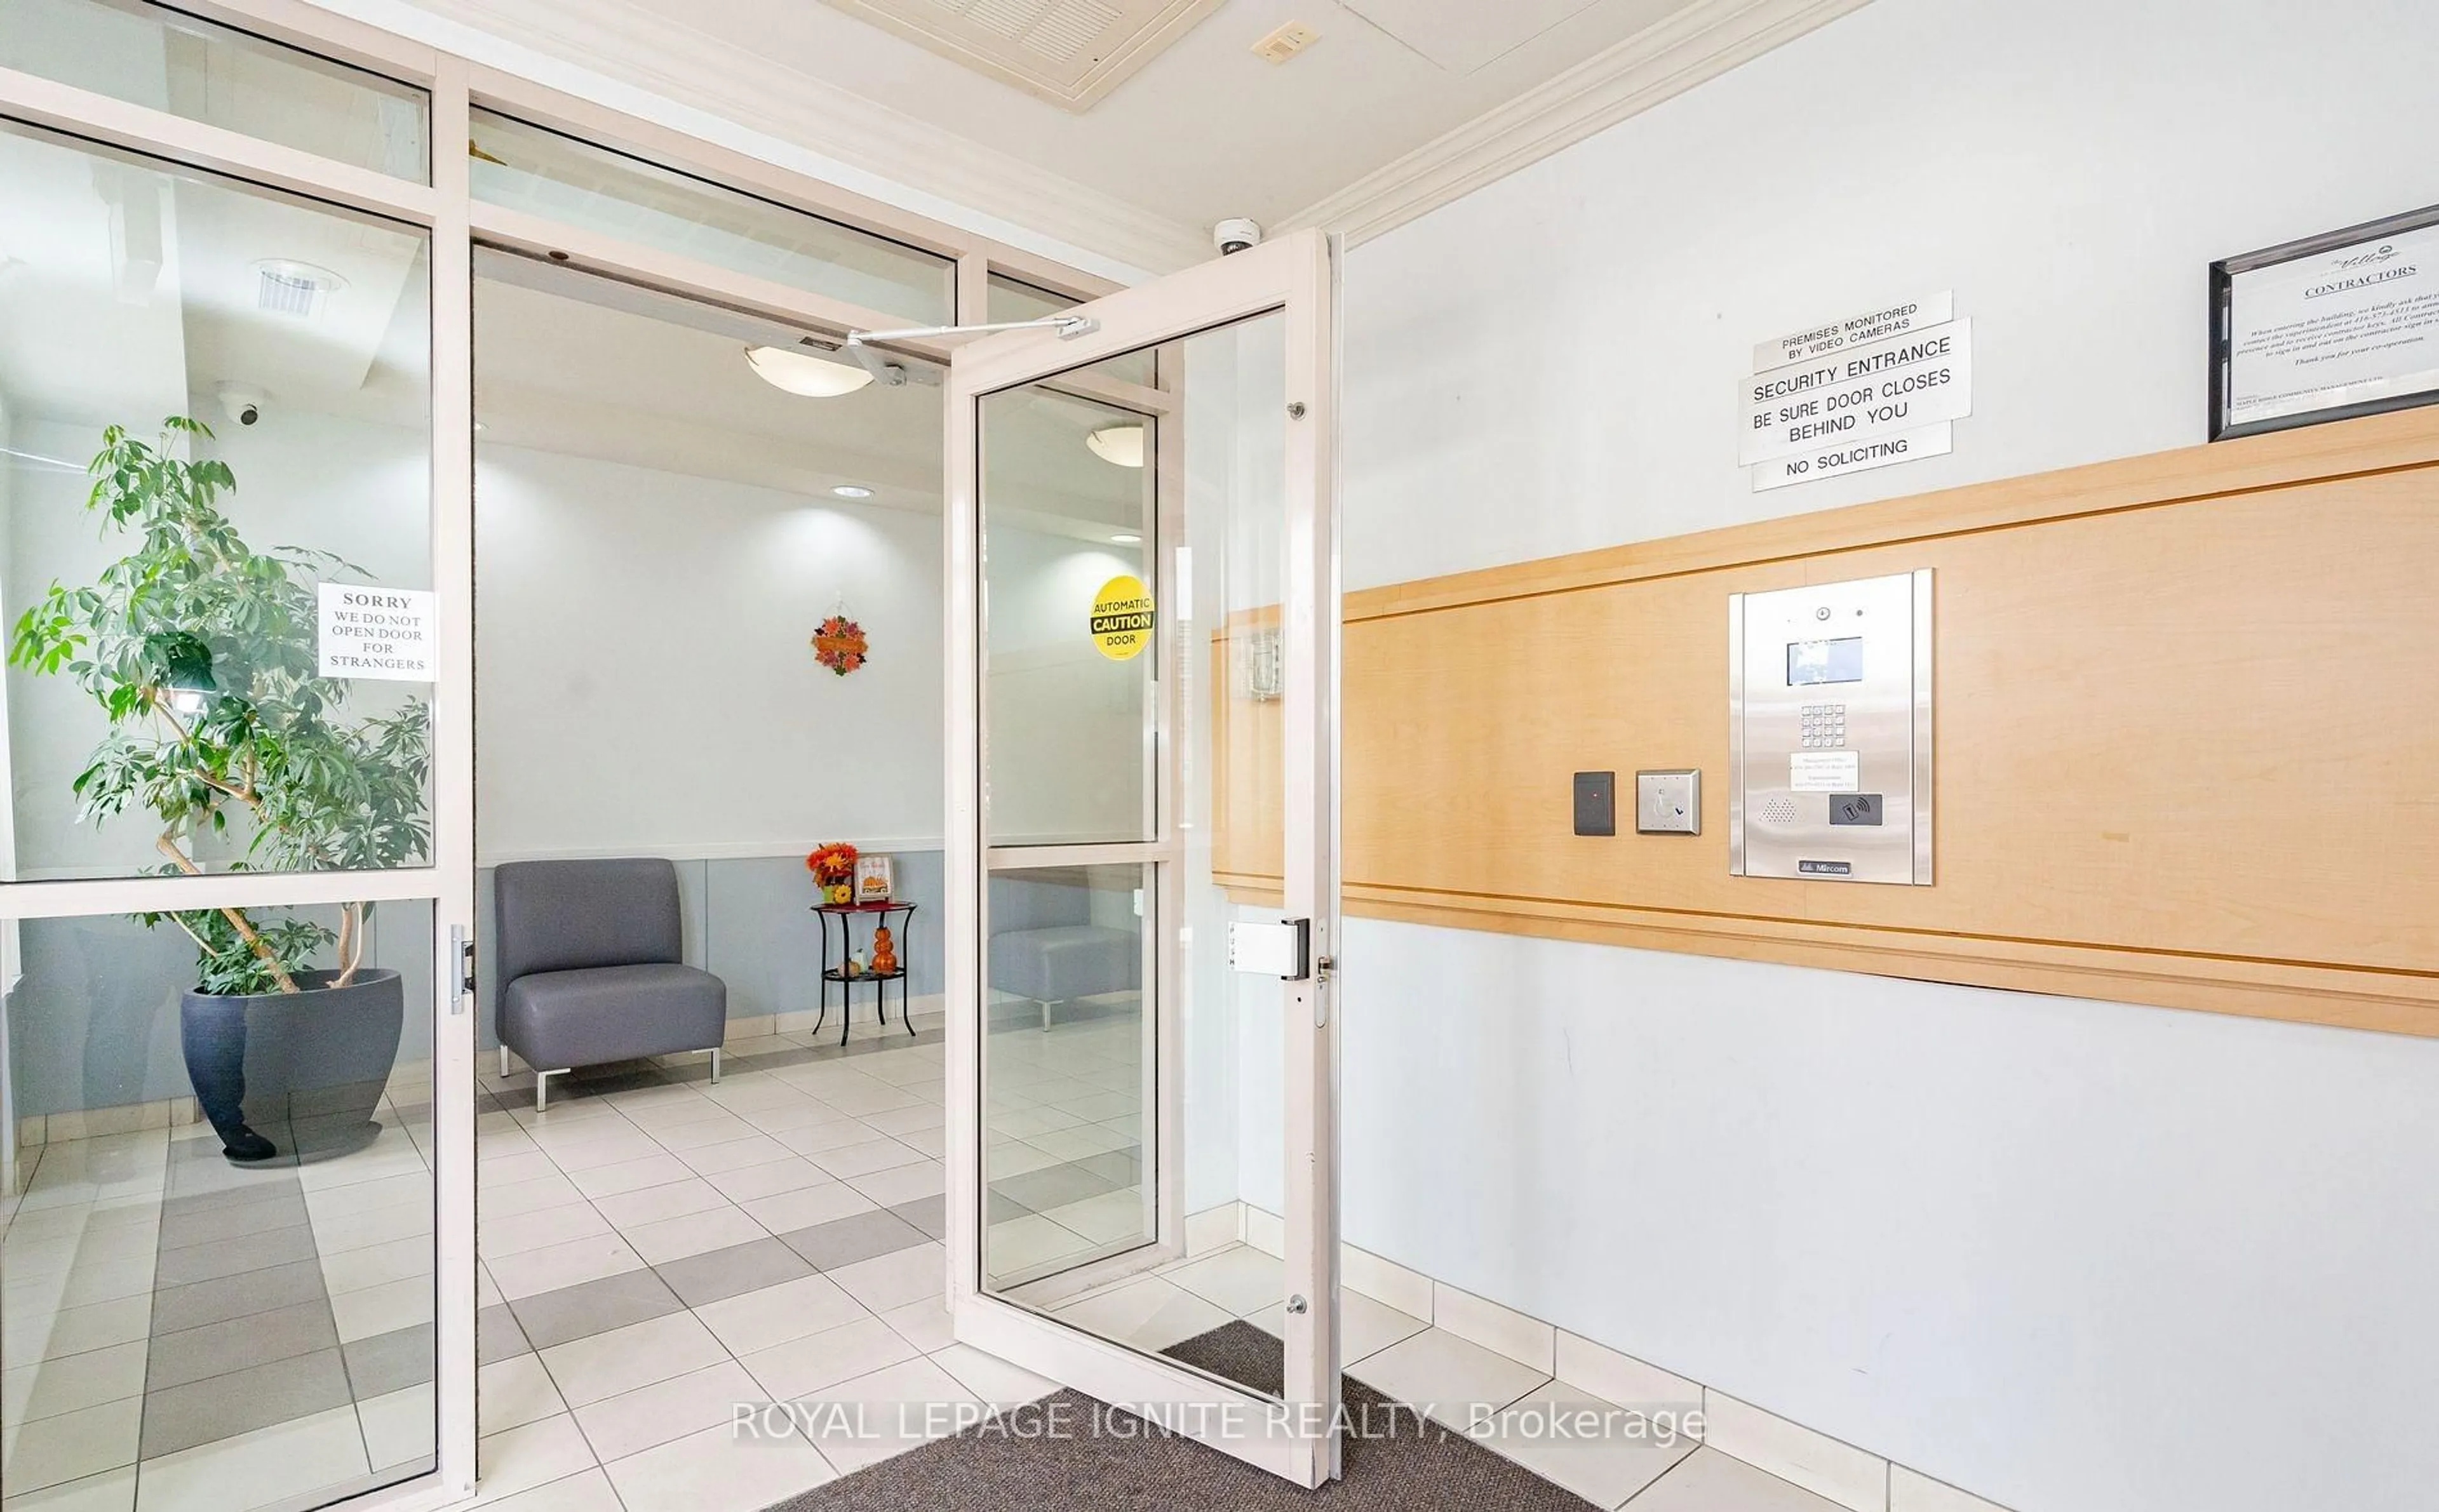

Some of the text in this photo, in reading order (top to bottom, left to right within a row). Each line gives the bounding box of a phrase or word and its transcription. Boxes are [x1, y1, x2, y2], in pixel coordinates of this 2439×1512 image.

[2305, 265, 2417, 297] CONTRACTORS
[2371, 302, 2396, 312] kindly
[2398, 297, 2412, 305] ask
[2415, 294, 2431, 303] that
[1782, 304, 1917, 349] PREMISES MONITORED
[1789, 318, 1910, 359] BY VIDEO CAMERAS
[2295, 356, 2319, 366] Thank
[2320, 354, 2335, 363] you
[2351, 347, 2370, 356] your
[1754, 337, 1951, 401] SECURITY ENTRANCE
[1754, 368, 1951, 429] BE SURE DOOR CLOSES
[1789, 402, 1908, 442] BEHIND YOU
[1787, 439, 1907, 476] NO SOLICITING
[343, 593, 412, 608] SORRY
[1094, 598, 1150, 613] AUTOMATIC
[334, 611, 421, 627] WE DO NOT
[1093, 615, 1151, 631] CAUTION
[332, 626, 422, 641] OPEN DOOR
[1106, 634, 1136, 646] DOOR
[363, 643, 393, 653] FOR
[330, 655, 424, 670] STRANGERS
[1816, 864, 1848, 873] Mircom
